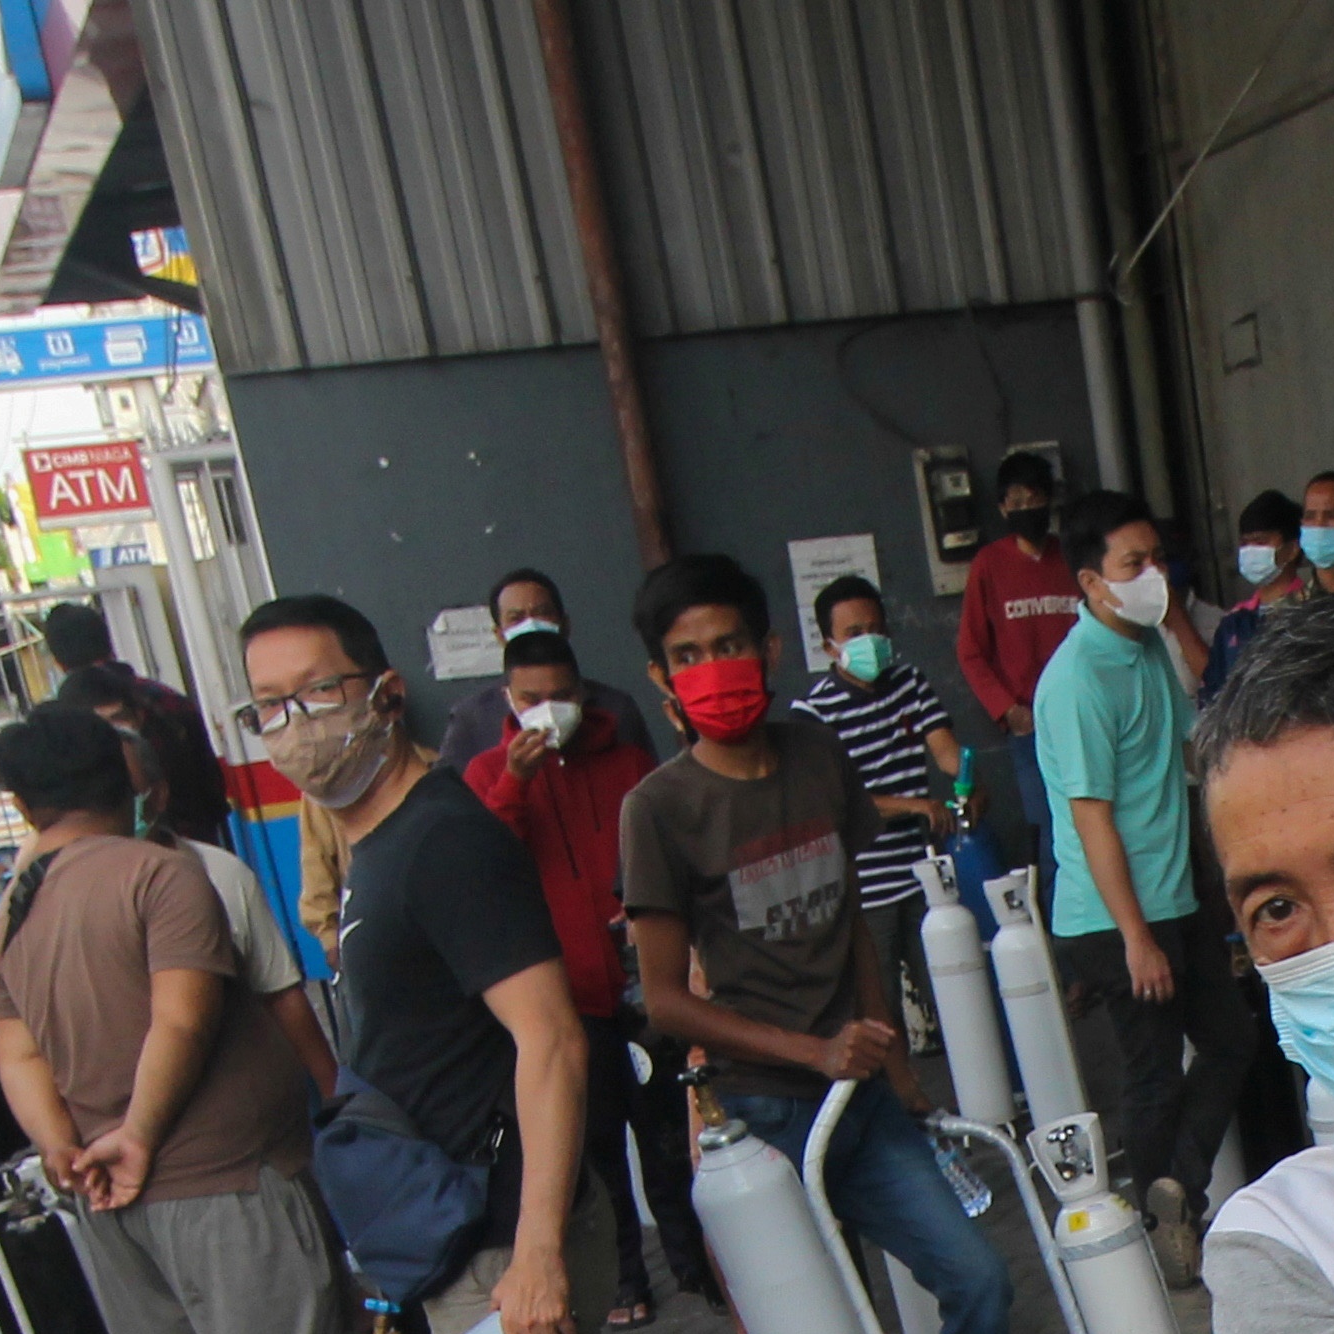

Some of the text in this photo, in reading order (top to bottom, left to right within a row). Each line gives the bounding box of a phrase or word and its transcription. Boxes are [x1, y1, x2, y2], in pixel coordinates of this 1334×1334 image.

[52, 450, 90, 468] CIMB
[49, 466, 139, 510] ATM
[117, 547, 151, 565] ATM
